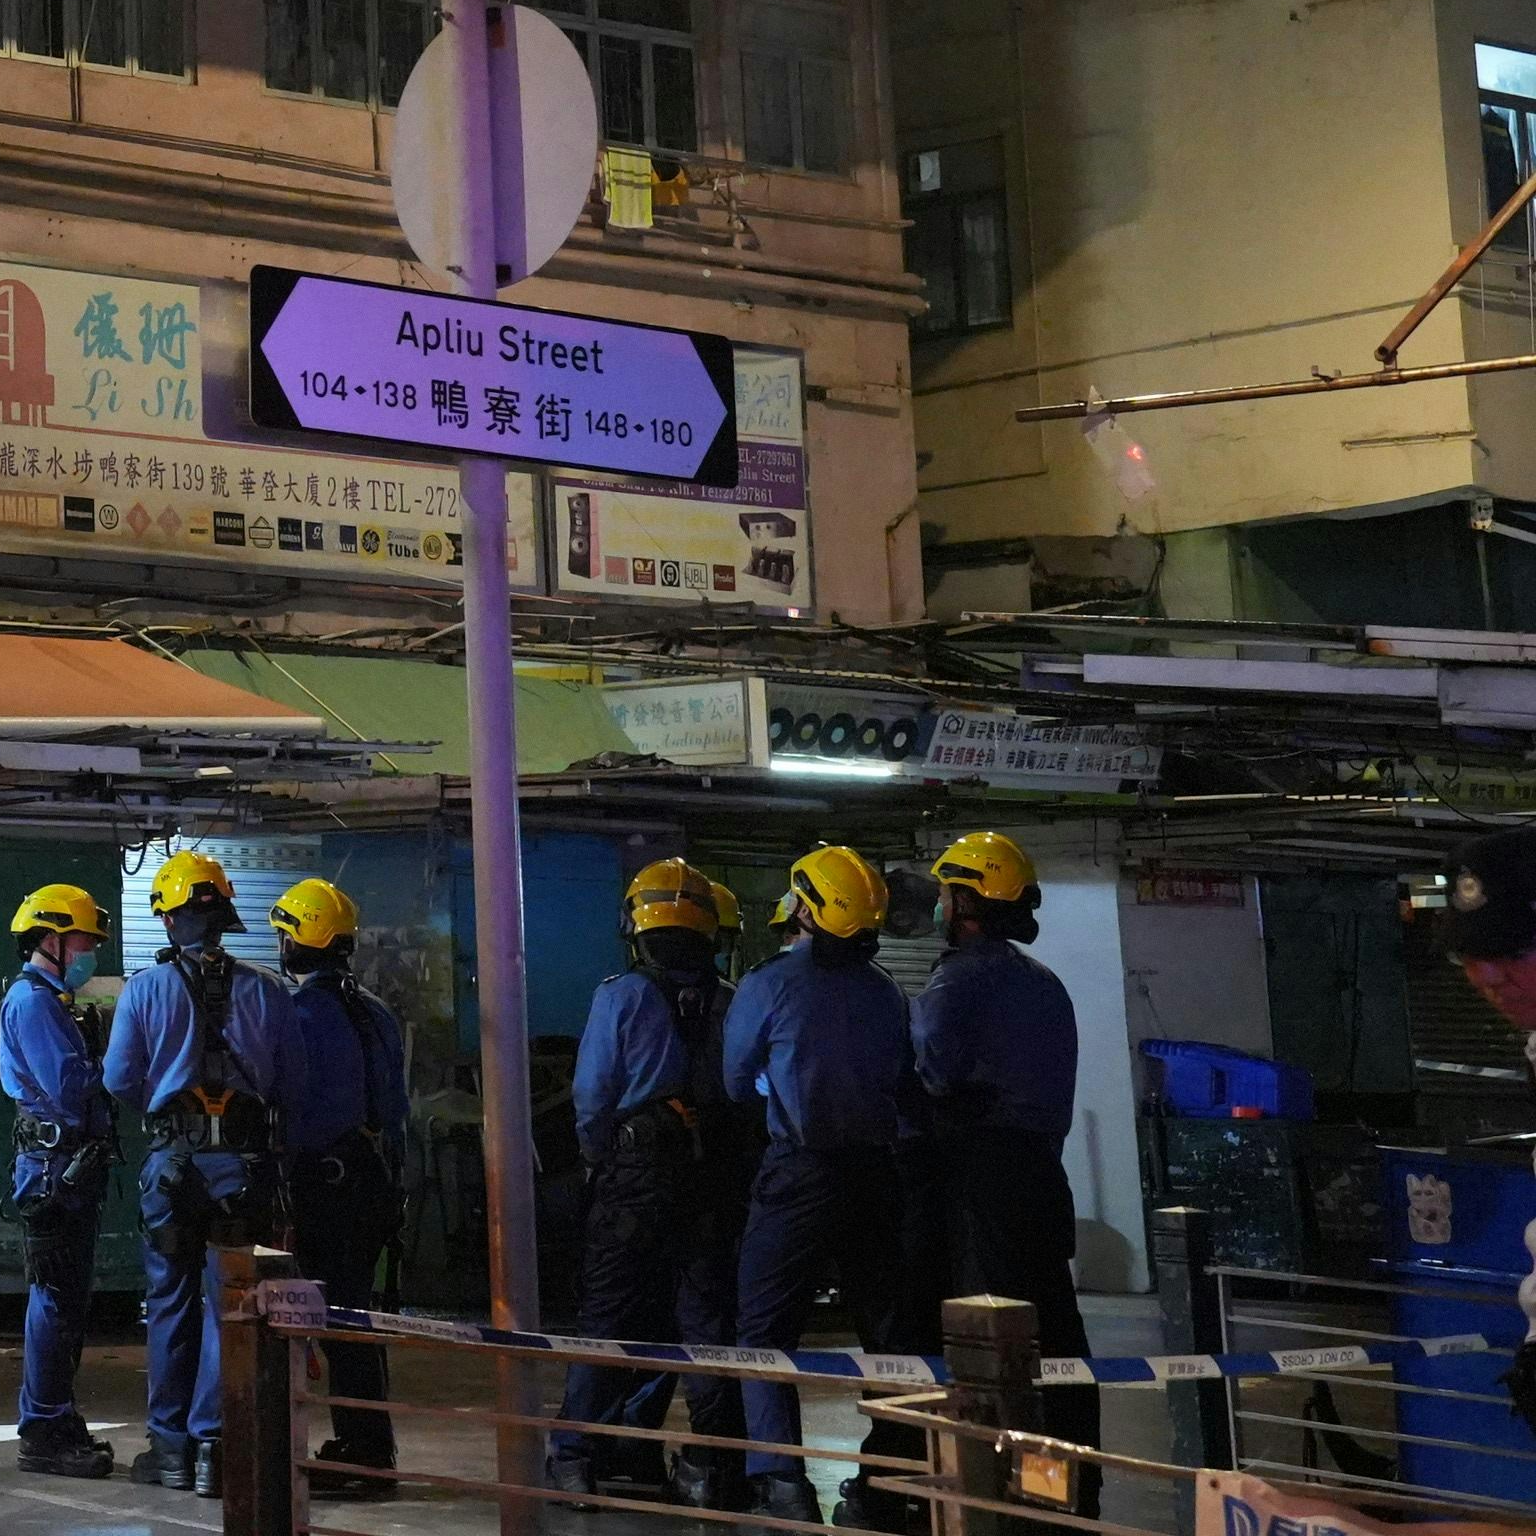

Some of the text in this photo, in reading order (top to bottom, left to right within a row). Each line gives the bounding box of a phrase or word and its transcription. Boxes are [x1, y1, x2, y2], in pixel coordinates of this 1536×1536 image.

[395, 310, 604, 375] Apliu Street
[140, 375, 199, 423] Sh
[299, 370, 693, 448] 104 138 鴨寮街 148 180
[738, 448, 797, 468] EL-27297861
[985, 861, 1002, 873] MK
[833, 897, 849, 912] MK
[691, 1346, 729, 1361] CROSS
[735, 1350, 756, 1364] NOT
[1282, 1355, 1314, 1368] CROSS
